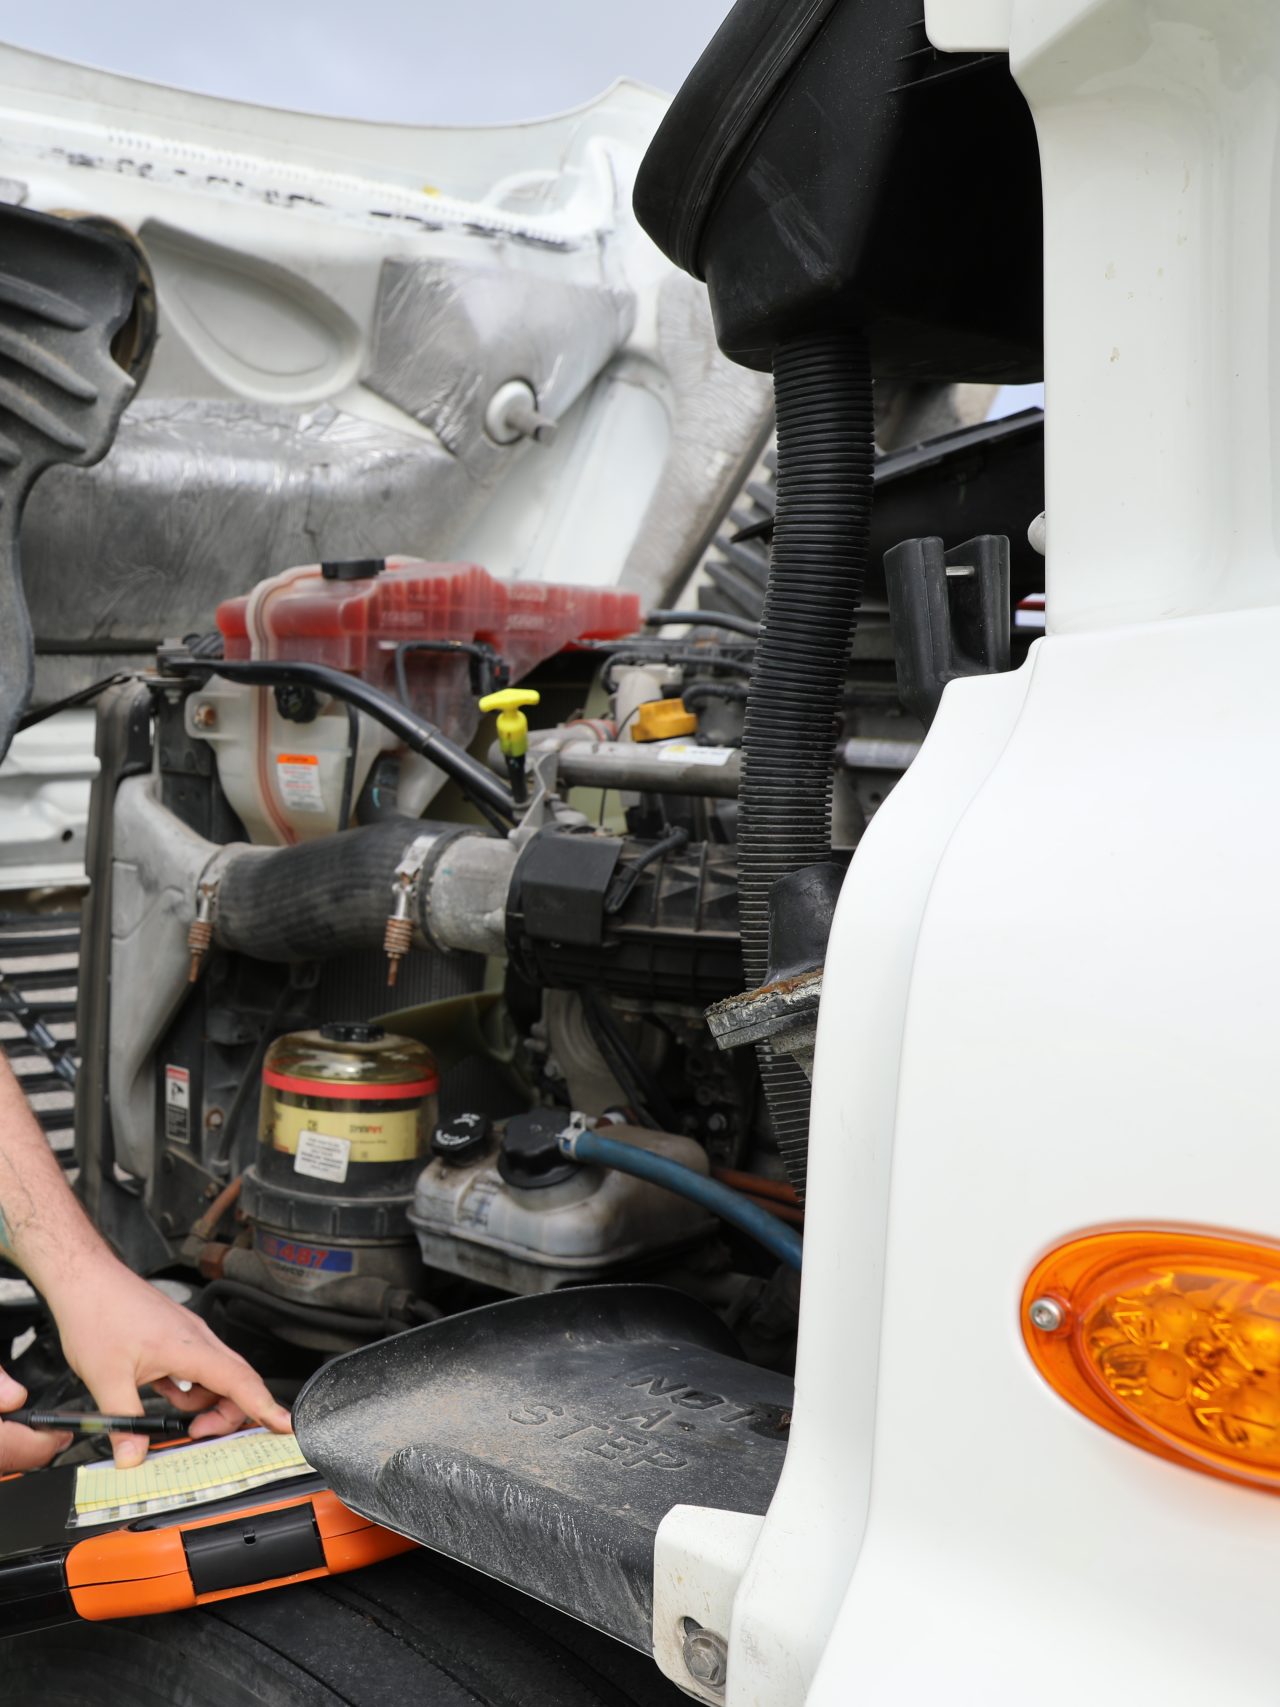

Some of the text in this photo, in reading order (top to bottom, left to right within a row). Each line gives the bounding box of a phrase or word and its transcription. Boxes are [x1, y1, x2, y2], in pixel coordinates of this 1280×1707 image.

[618, 1406, 672, 1431] A
[625, 1375, 766, 1423] NOT
[508, 1402, 688, 1469] STEP
